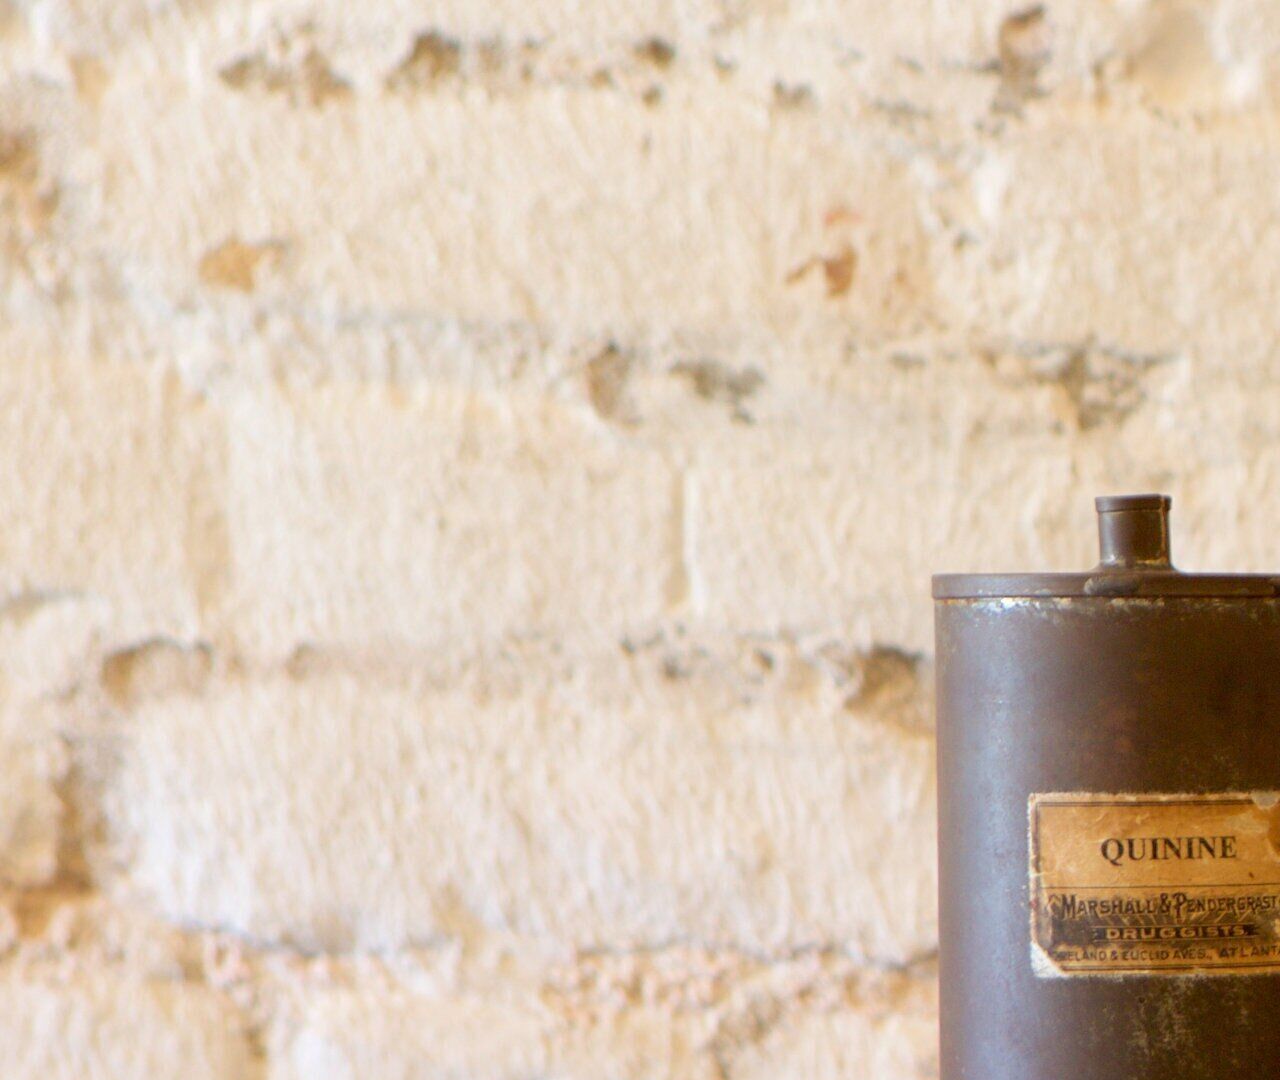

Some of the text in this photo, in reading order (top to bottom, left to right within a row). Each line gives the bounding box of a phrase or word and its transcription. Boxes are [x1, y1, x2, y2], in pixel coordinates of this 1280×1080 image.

[1100, 835, 1237, 866] QUININE
[1061, 892, 1279, 922] MARSHALL & PENDERGRAST
